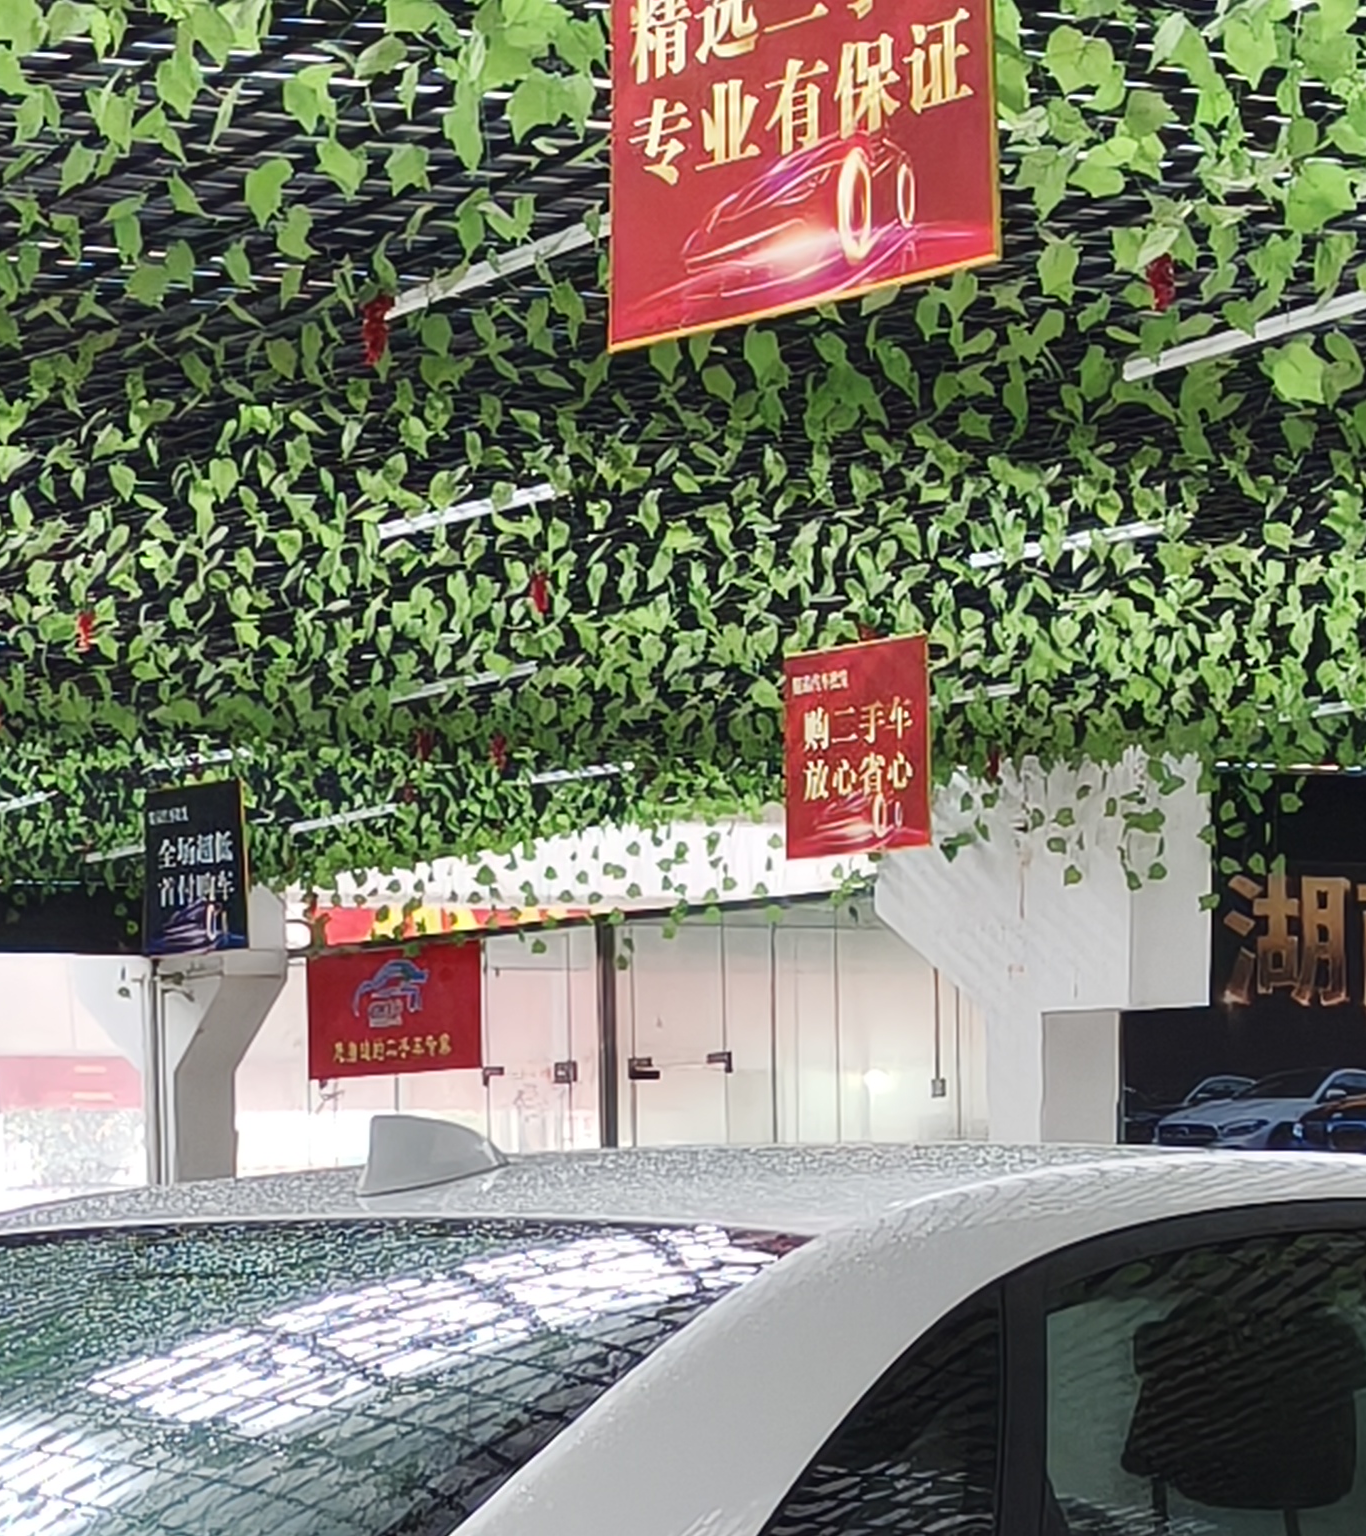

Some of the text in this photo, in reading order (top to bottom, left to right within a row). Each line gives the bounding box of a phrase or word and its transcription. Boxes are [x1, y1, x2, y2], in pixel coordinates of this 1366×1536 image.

[629, 0, 875, 84] 精选二
[629, 9, 974, 185] 专业有保证
[803, 695, 913, 752] 购二手车
[803, 751, 913, 801] 放心省心
[157, 831, 234, 870] 全场超低
